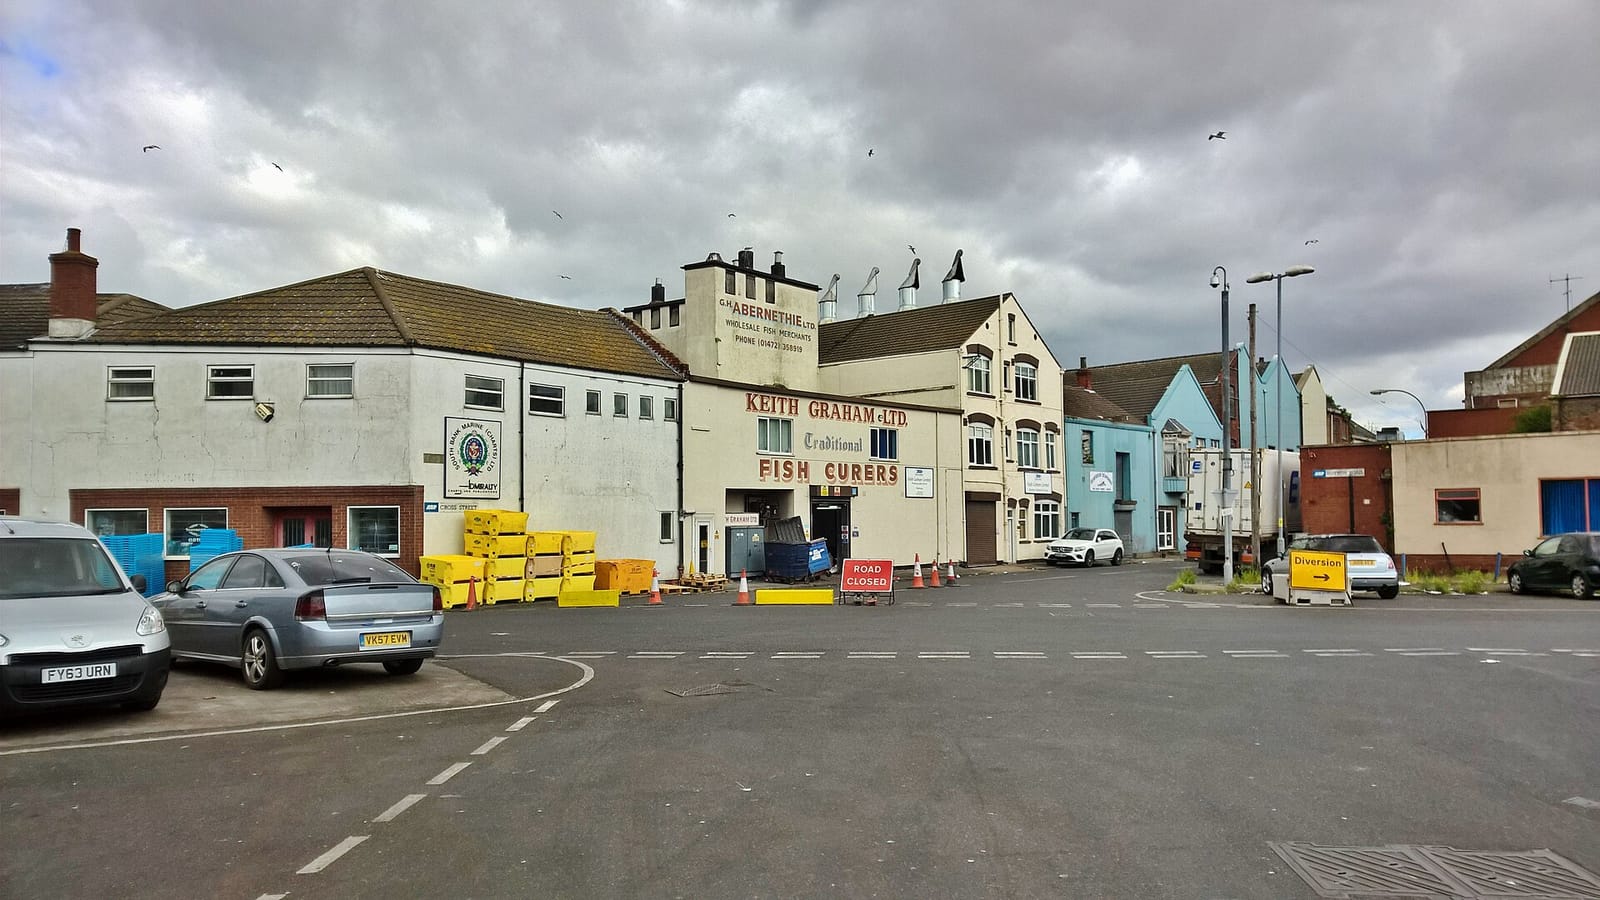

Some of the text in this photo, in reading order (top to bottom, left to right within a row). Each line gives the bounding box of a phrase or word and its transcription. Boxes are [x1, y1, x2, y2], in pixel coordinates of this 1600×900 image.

[732, 301, 802, 327] ABERNETHIE
[802, 321, 817, 330] LTD.
[725, 318, 812, 342] WHOLESALE FISH MERCHANTS
[735, 334, 756, 345] PHONE
[745, 392, 799, 416] KEITH
[808, 399, 875, 424] GRAHAM
[461, 422, 483, 430] MARINE
[449, 428, 461, 446] BANK
[804, 431, 863, 452] Traditional
[449, 447, 461, 471] SOUTH
[759, 458, 810, 483] FISH
[824, 462, 899, 486] CURERS
[853, 565, 882, 574] ROAD
[1294, 556, 1342, 567] Diversion
[846, 577, 887, 586] CLOSED
[366, 633, 408, 645] VK57 EVM
[47, 664, 111, 681] FY63 URN
